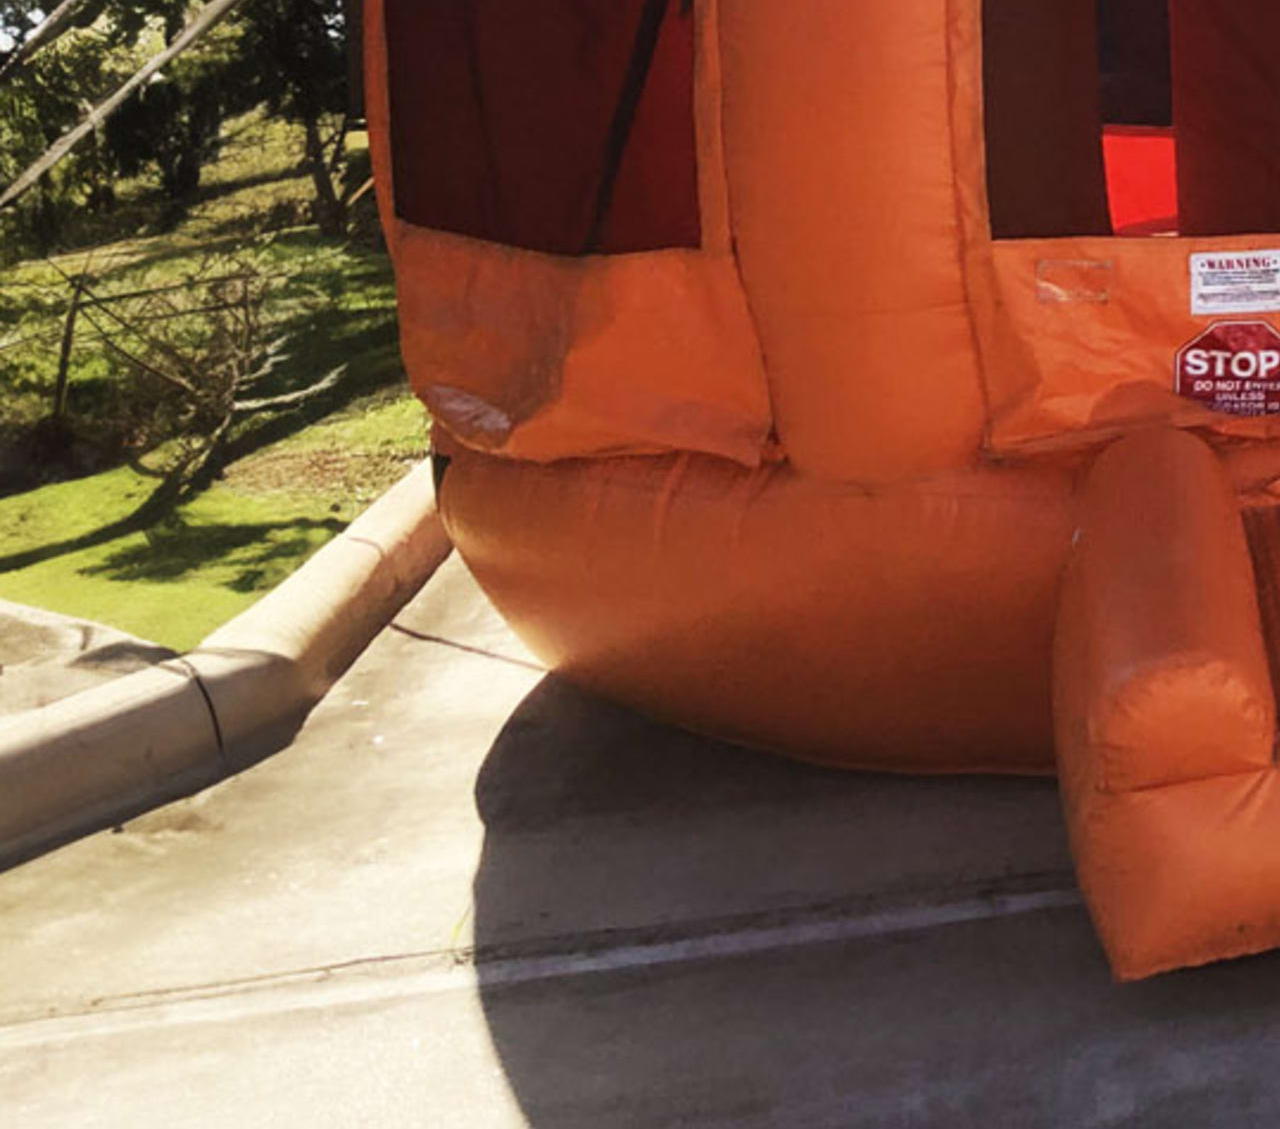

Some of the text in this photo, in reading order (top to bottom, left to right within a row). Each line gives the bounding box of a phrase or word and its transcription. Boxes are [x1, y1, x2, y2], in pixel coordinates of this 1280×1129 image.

[1206, 257, 1270, 270] WARNING
[1193, 380, 1213, 391] DO
[1215, 380, 1241, 391] NOT
